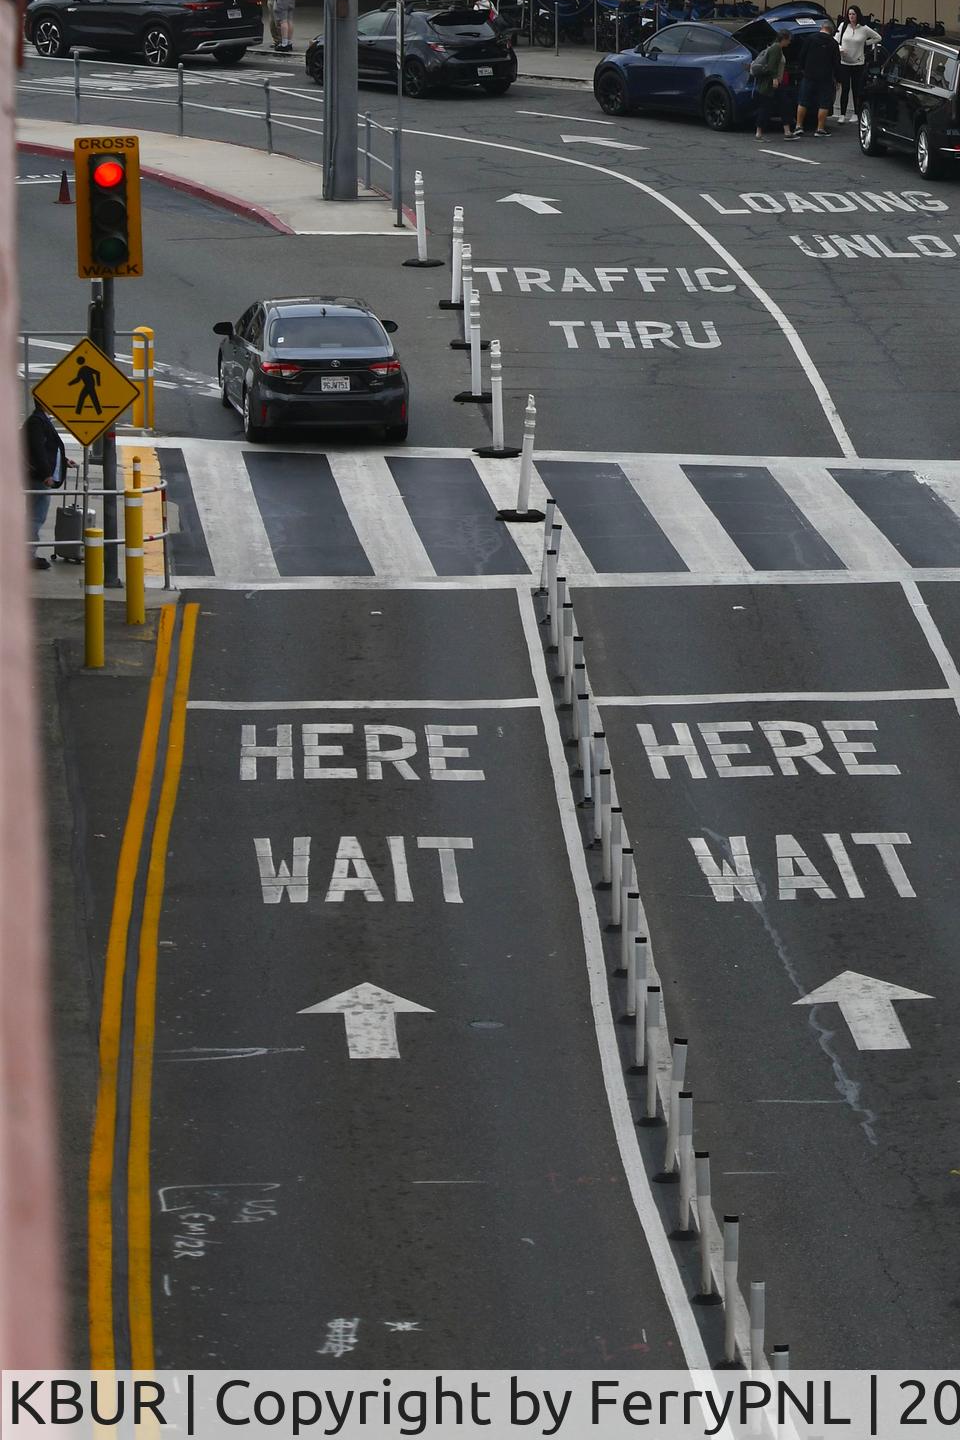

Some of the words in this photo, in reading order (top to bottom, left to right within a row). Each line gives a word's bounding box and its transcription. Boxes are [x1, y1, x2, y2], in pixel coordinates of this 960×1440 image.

[79, 137, 135, 150] CROSS
[699, 190, 950, 215] LOADING
[472, 266, 737, 293] TRAFFIC
[548, 320, 722, 350] THRU
[239, 723, 486, 781] HERE
[636, 720, 901, 779] HERE
[253, 835, 474, 904] WAIT
[688, 832, 917, 902] WAIT
